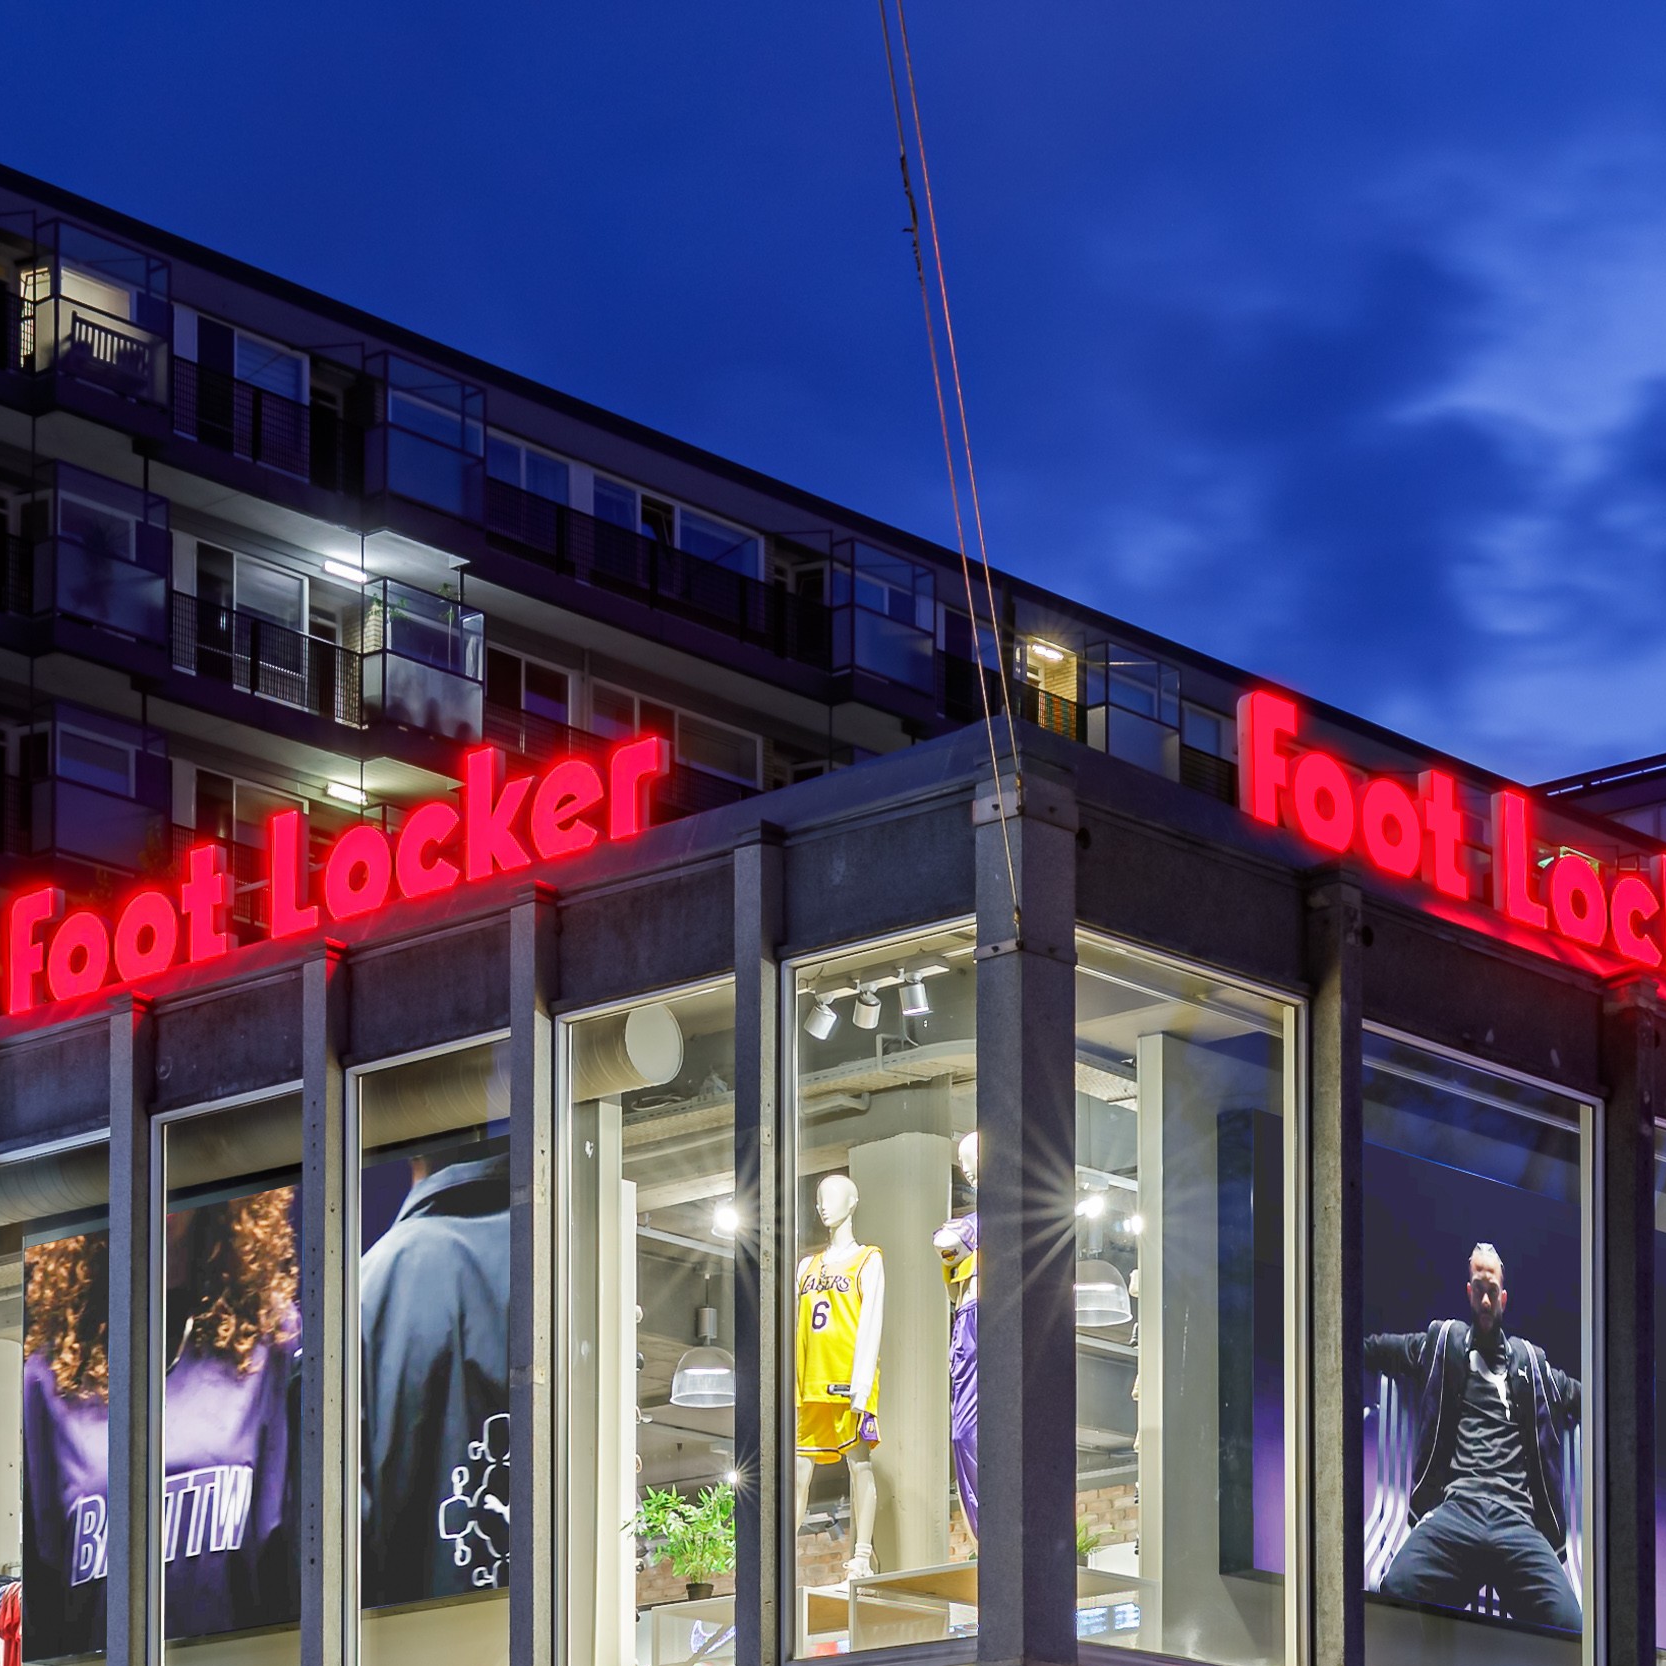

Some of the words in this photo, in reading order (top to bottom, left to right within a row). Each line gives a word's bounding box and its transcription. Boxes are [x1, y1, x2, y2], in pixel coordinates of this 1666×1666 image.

[7, 845, 237, 1015] Foot
[270, 735, 670, 940] Locker
[1238, 690, 1469, 900] Foot
[811, 1300, 830, 1331] 6
